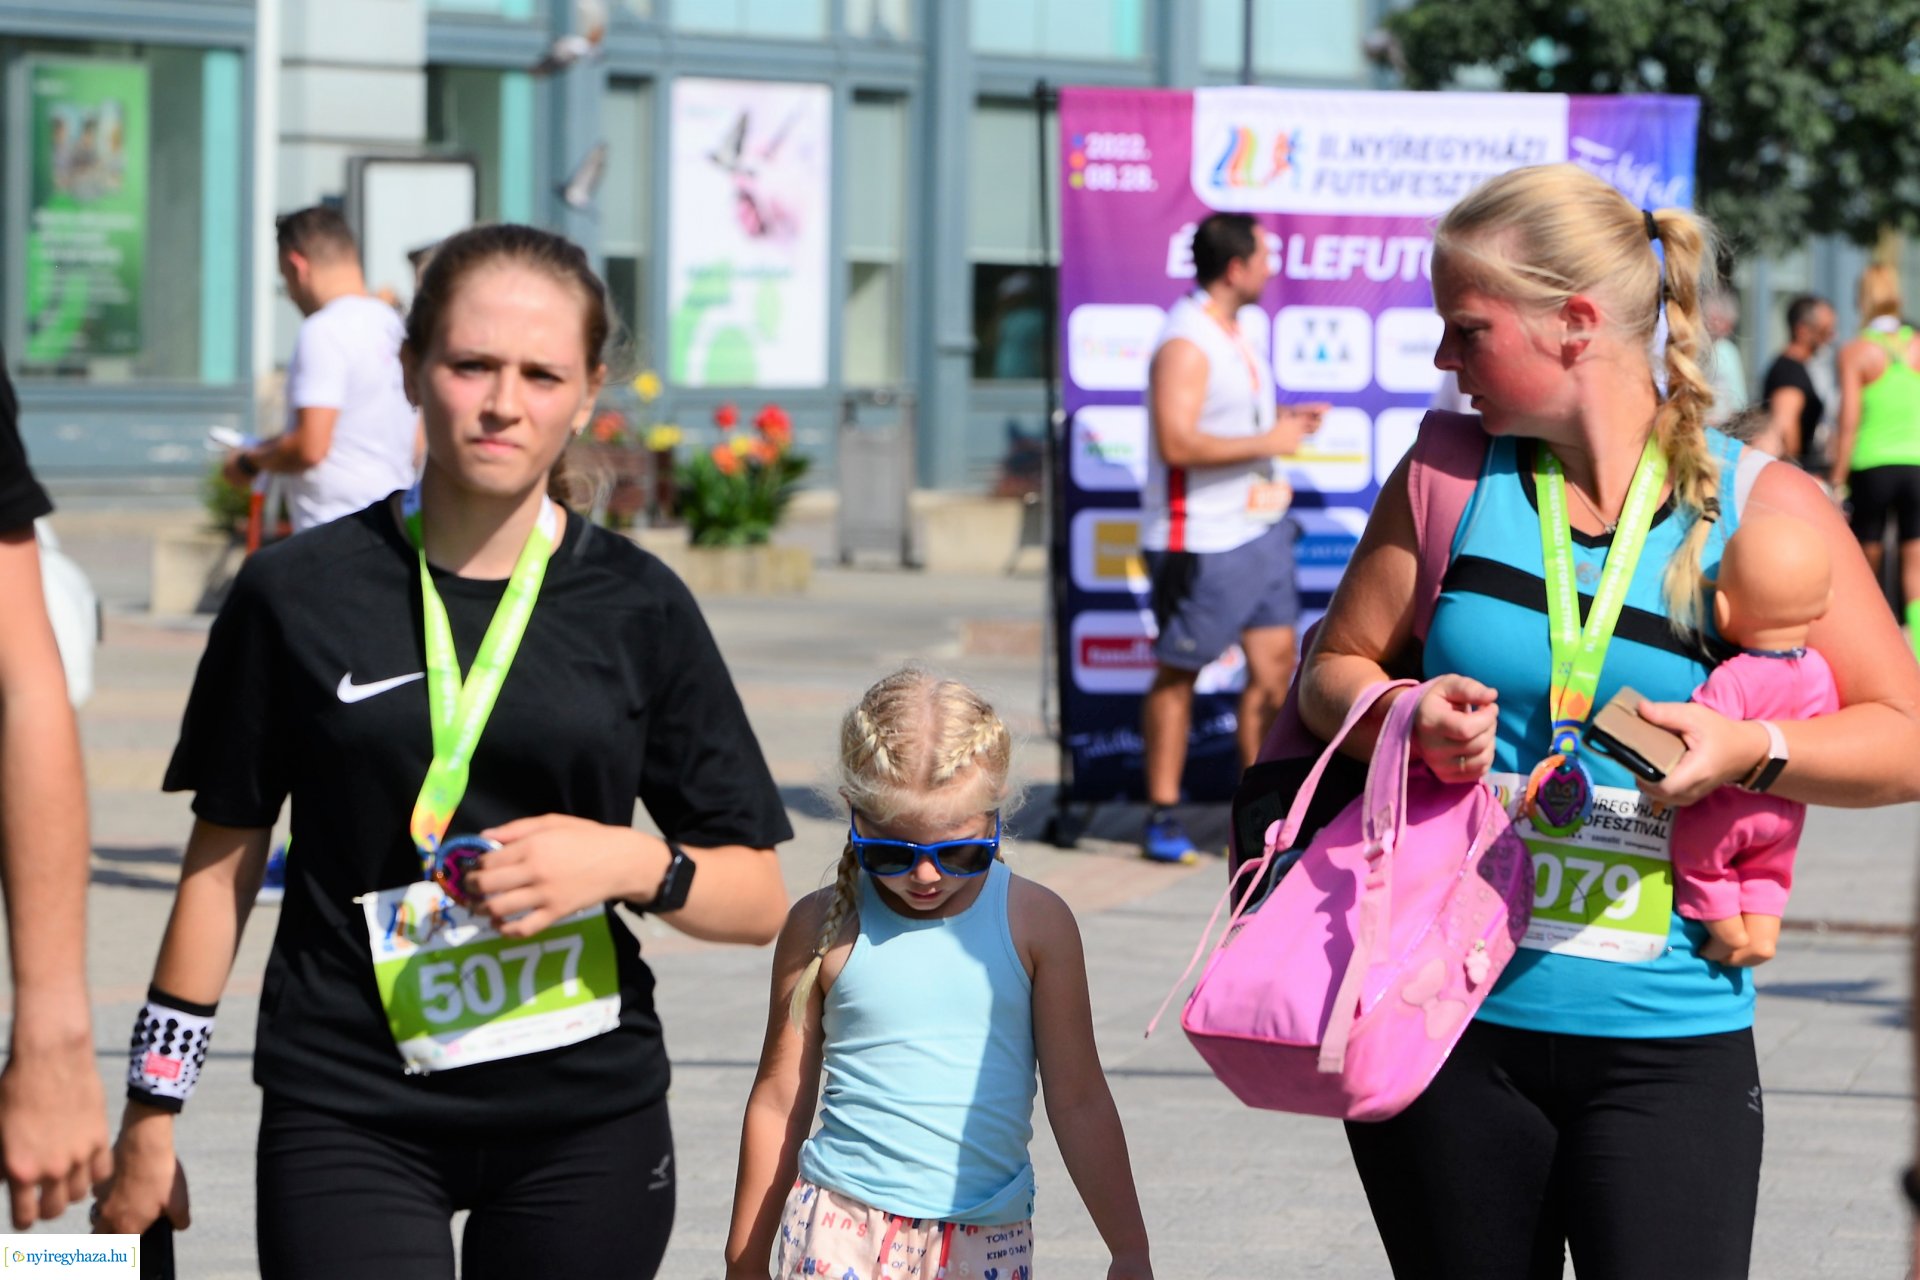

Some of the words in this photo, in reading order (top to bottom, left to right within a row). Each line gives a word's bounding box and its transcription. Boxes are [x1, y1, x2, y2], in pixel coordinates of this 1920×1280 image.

[1285, 233, 1432, 282] LEFUT
[1533, 852, 1641, 921] 079
[418, 934, 583, 1024] 5077
